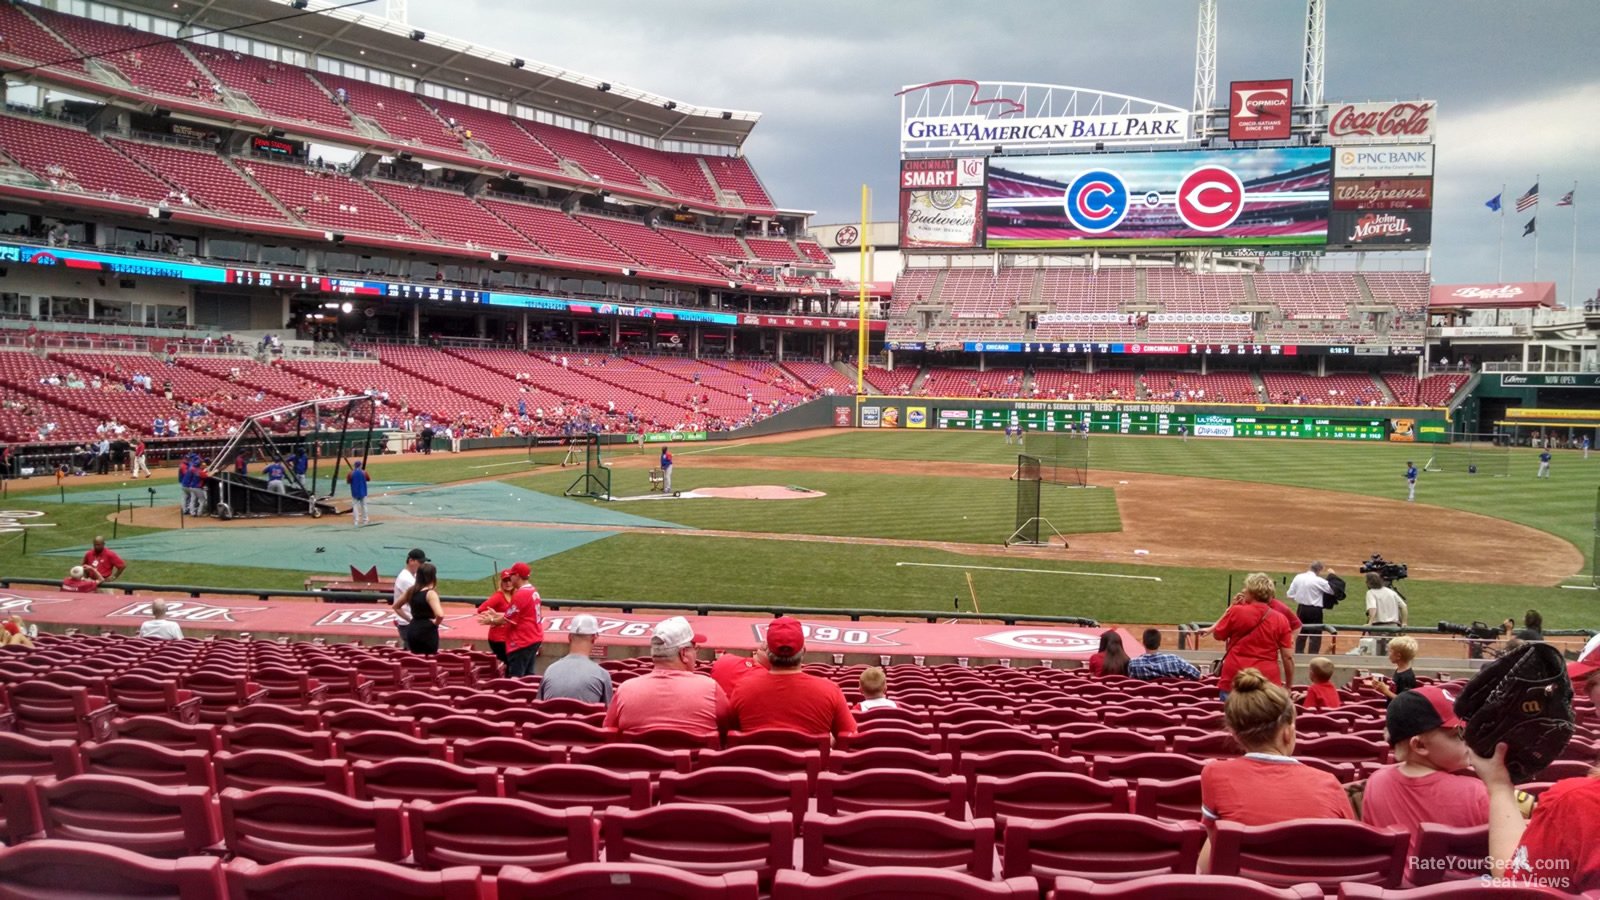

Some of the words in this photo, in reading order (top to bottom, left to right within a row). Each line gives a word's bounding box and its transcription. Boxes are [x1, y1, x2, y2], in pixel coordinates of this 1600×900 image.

[1329, 103, 1434, 137] Coca-Cola
[908, 121, 972, 138] GREAT
[966, 124, 1067, 141] AMERICAN
[1070, 120, 1121, 137] BALL
[1124, 118, 1180, 136] PARK
[904, 160, 954, 169] CINCINNATI
[1357, 153, 1387, 163] PNC
[1389, 152, 1426, 162] BANK
[905, 171, 954, 186] SMART
[1338, 185, 1426, 203] Walgreens
[908, 208, 974, 226] Budweiser
[1372, 214, 1396, 224] John
[1349, 219, 1411, 240] Morrell
[1560, 376, 1576, 384] OPEN
[548, 617, 650, 636] 176
